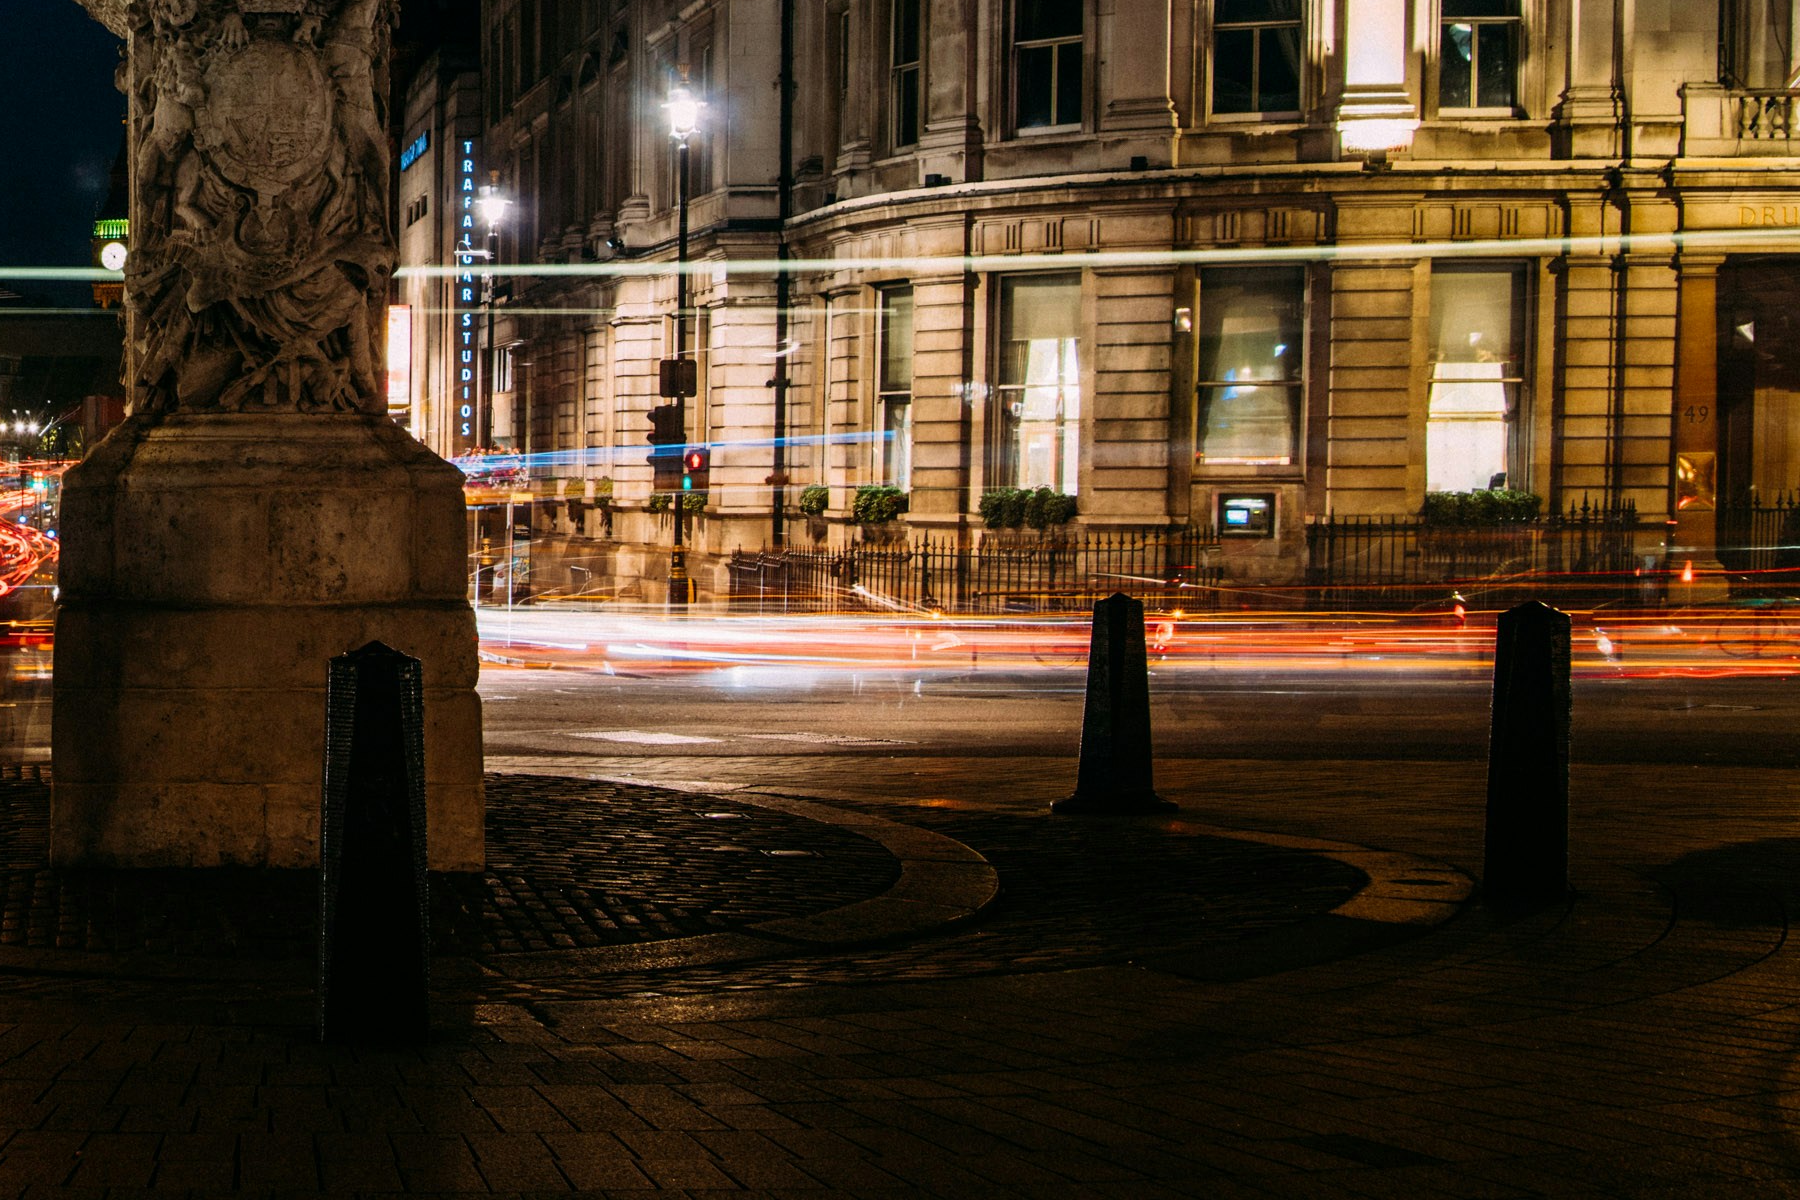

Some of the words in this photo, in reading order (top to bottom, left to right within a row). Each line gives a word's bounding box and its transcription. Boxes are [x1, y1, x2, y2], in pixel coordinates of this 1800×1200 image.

[462, 141, 473, 301] TRAFALGAR
[461, 313, 472, 437] STUDIOS
[1684, 405, 1709, 424] 49
